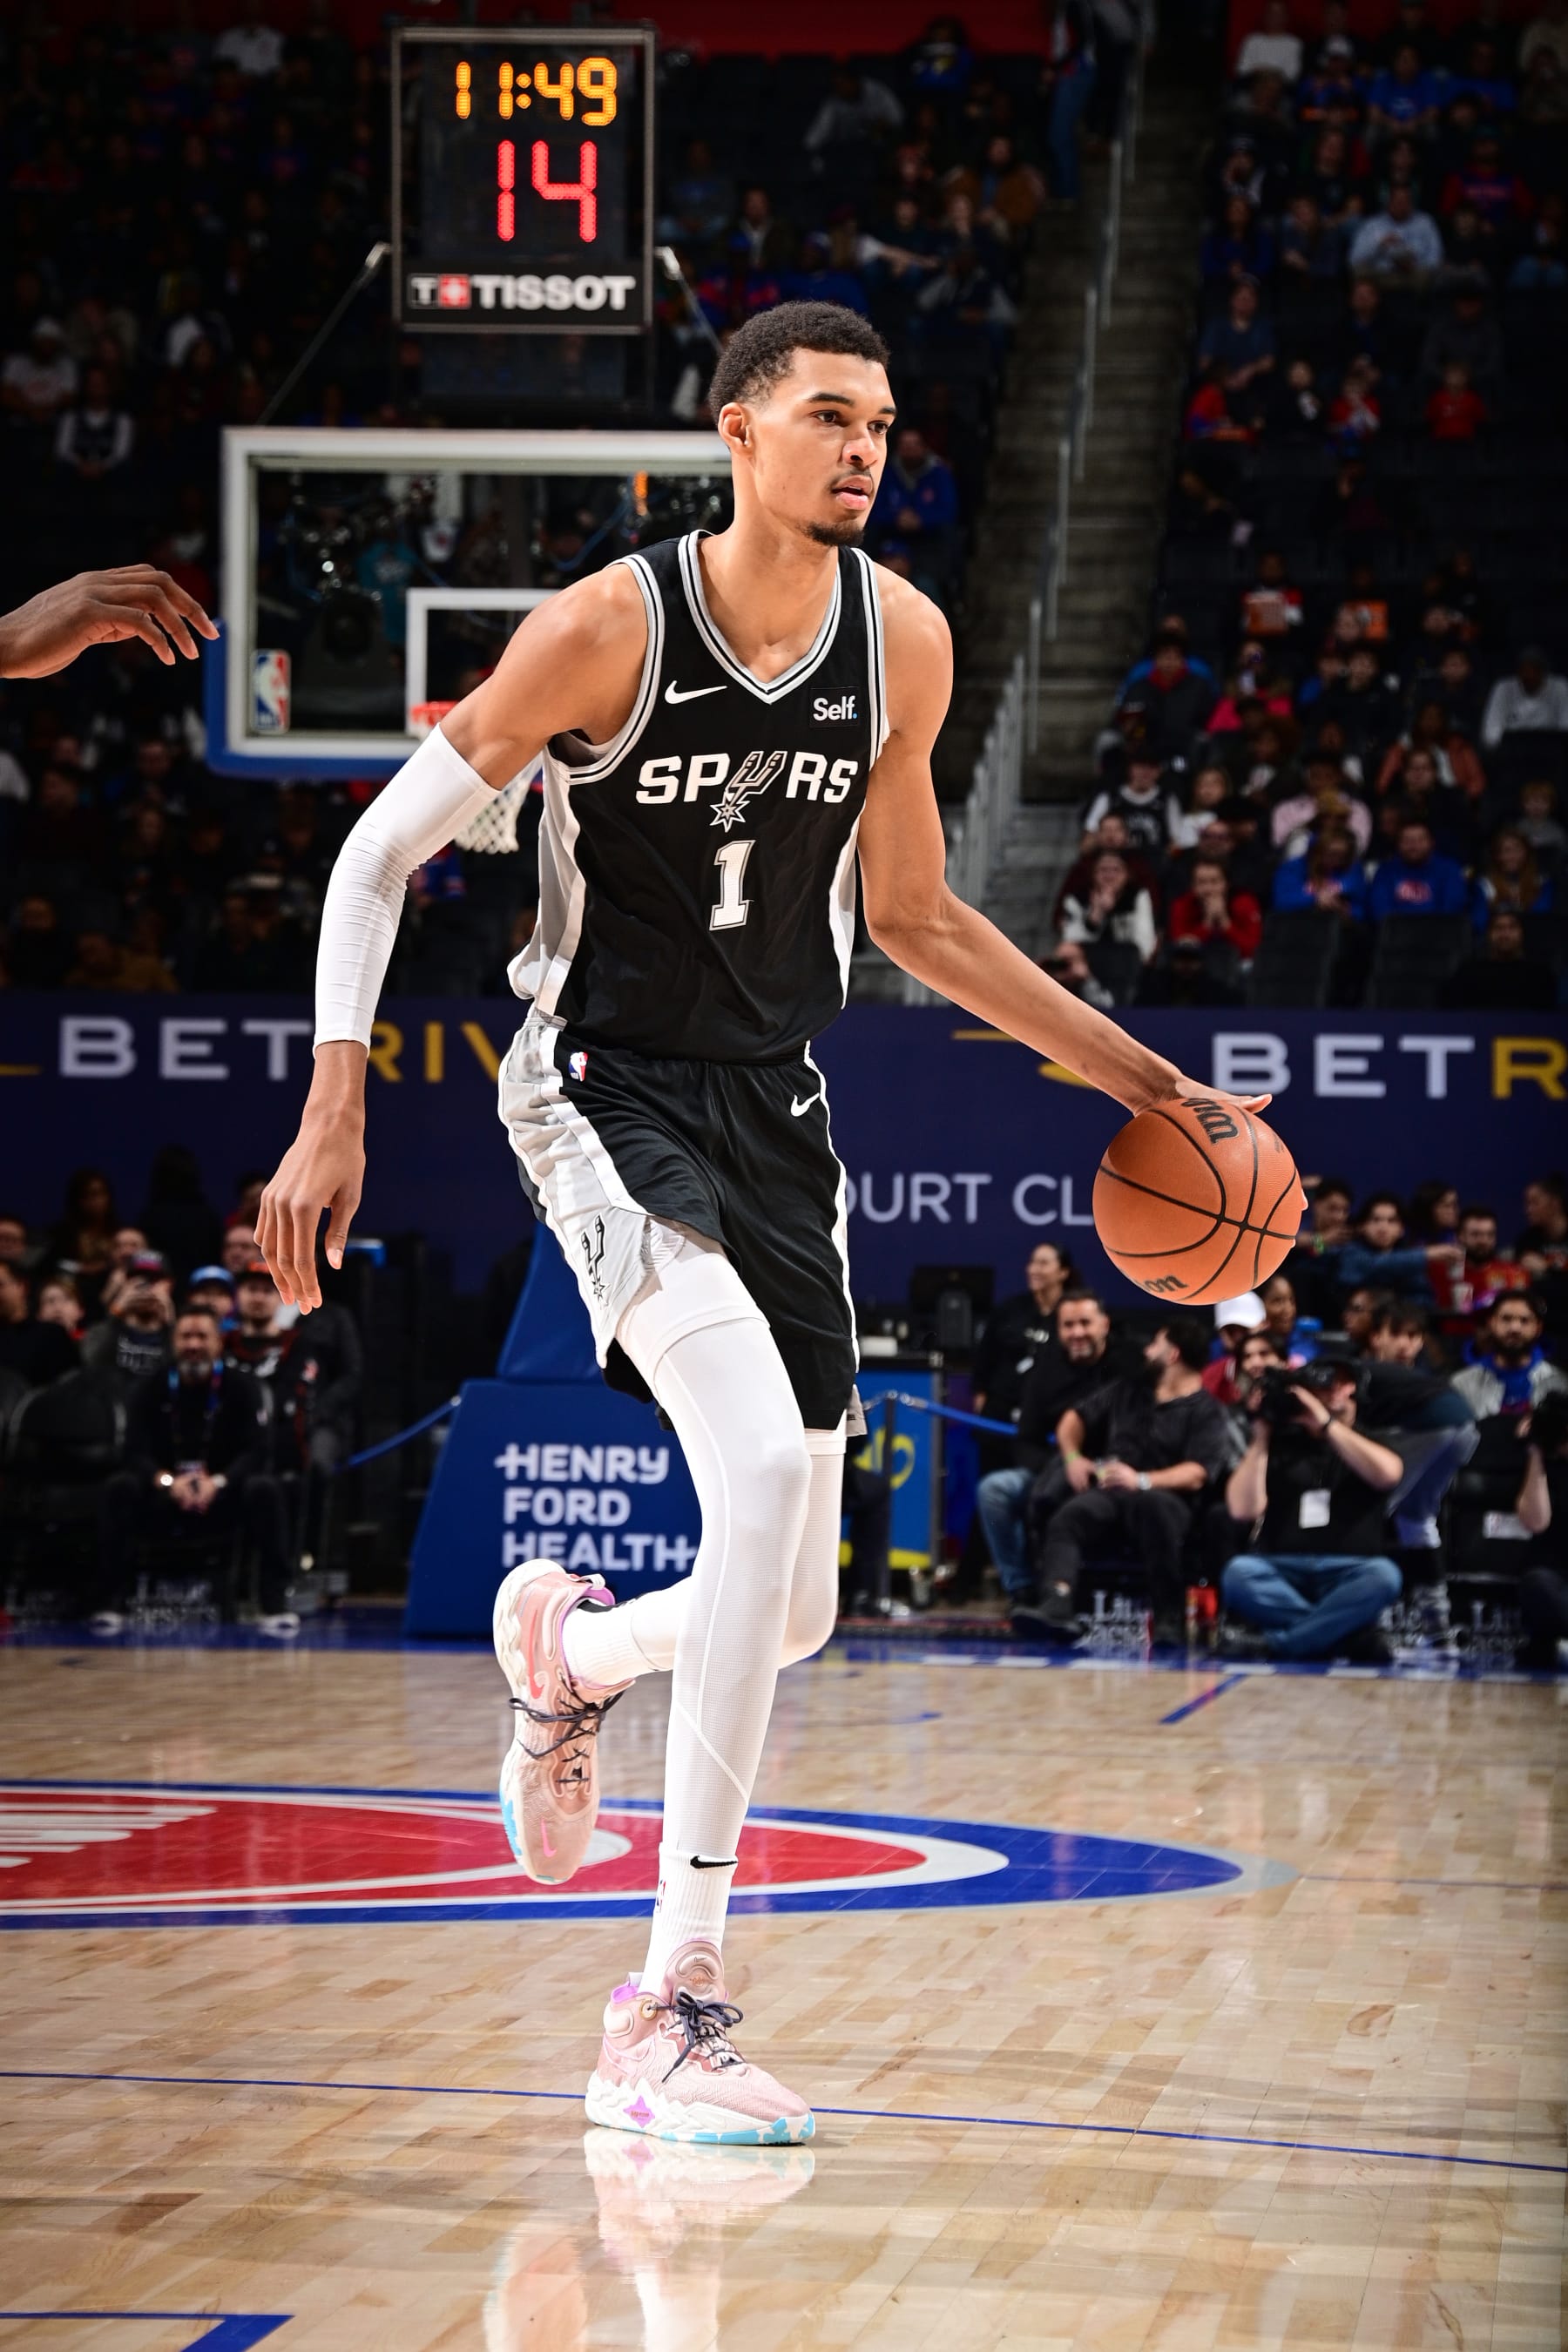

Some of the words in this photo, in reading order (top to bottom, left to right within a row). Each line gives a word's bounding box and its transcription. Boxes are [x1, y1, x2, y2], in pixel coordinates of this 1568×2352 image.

[456, 57, 617, 126] 11:49
[497, 139, 597, 242] 14
[471, 275, 636, 311] TISSOT
[635, 750, 859, 832] SPURS
[709, 840, 755, 930] 1
[494, 1443, 669, 1484] HENRY
[504, 1486, 631, 1527] FORD
[502, 1531, 697, 1572] HEALTH
